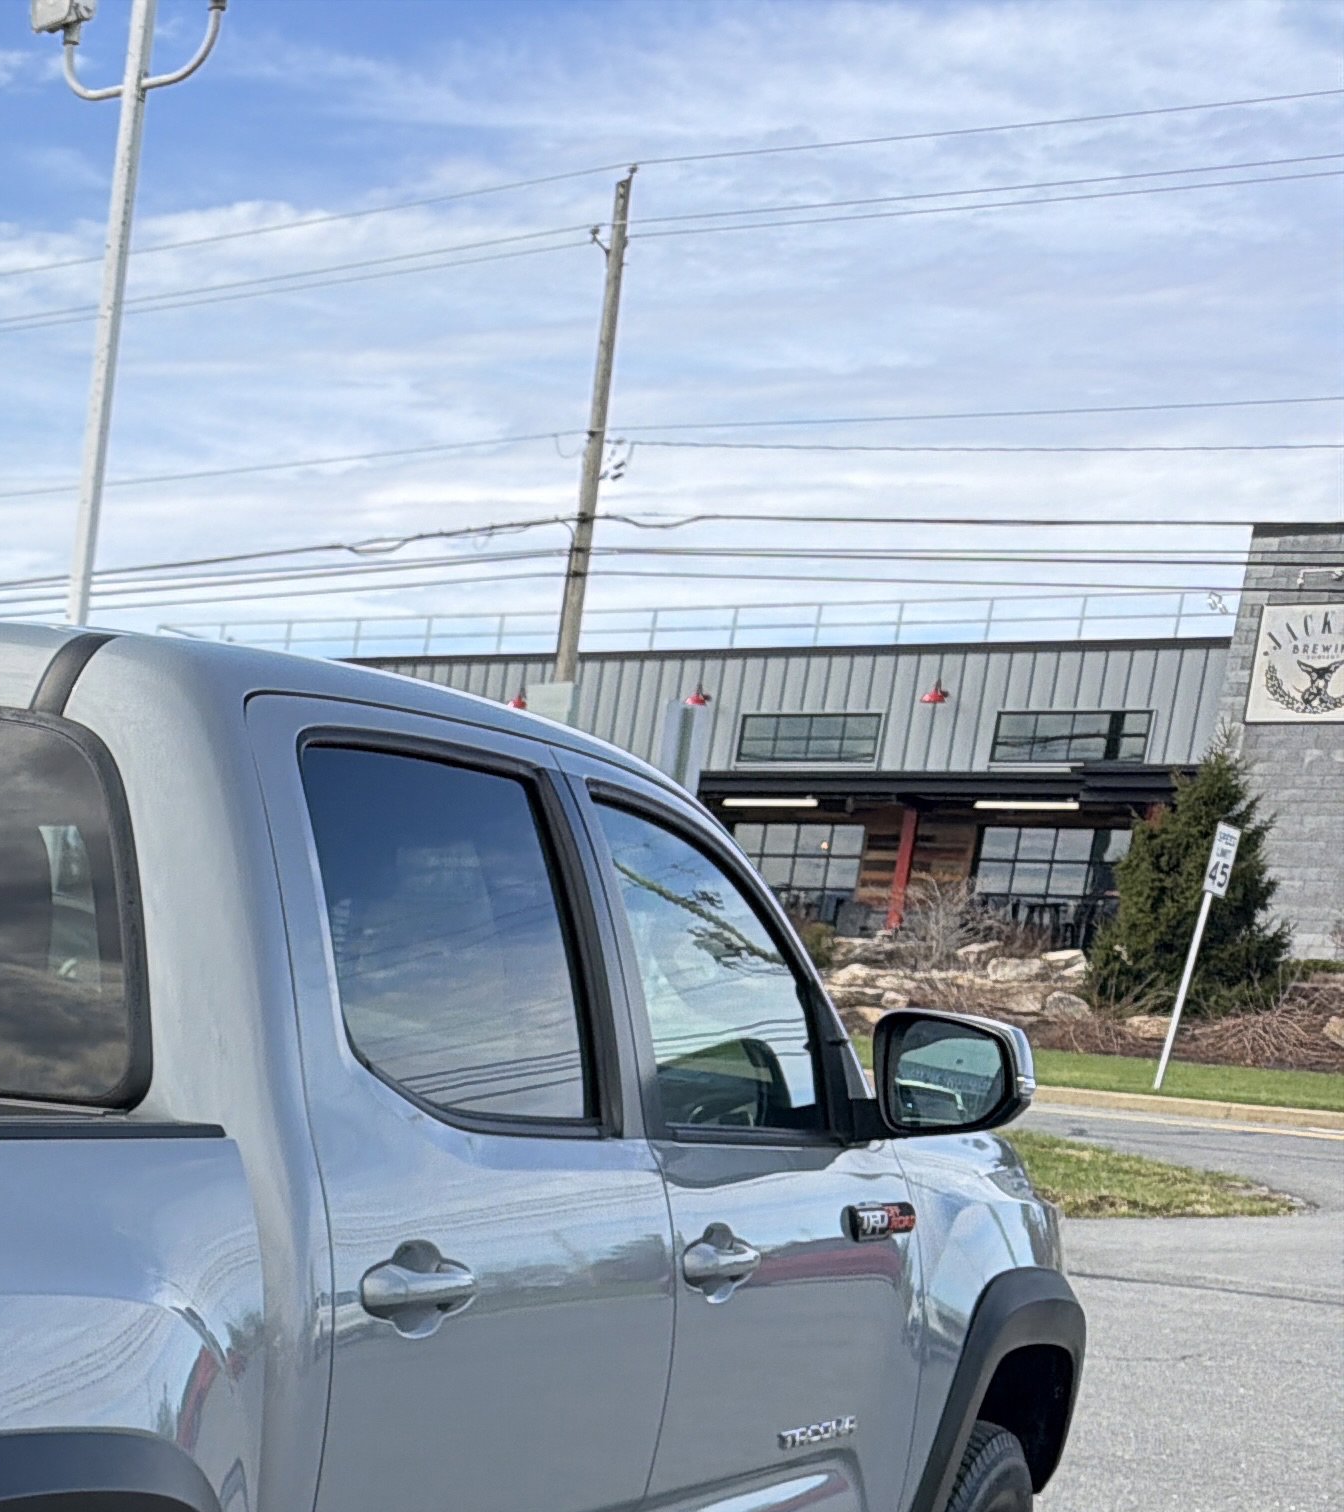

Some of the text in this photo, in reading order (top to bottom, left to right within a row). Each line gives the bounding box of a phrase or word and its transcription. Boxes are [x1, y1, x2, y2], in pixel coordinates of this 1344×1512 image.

[1269, 612, 1344, 649] JACK
[1209, 861, 1229, 888] 45
[778, 1415, 858, 1449] TACOMA
